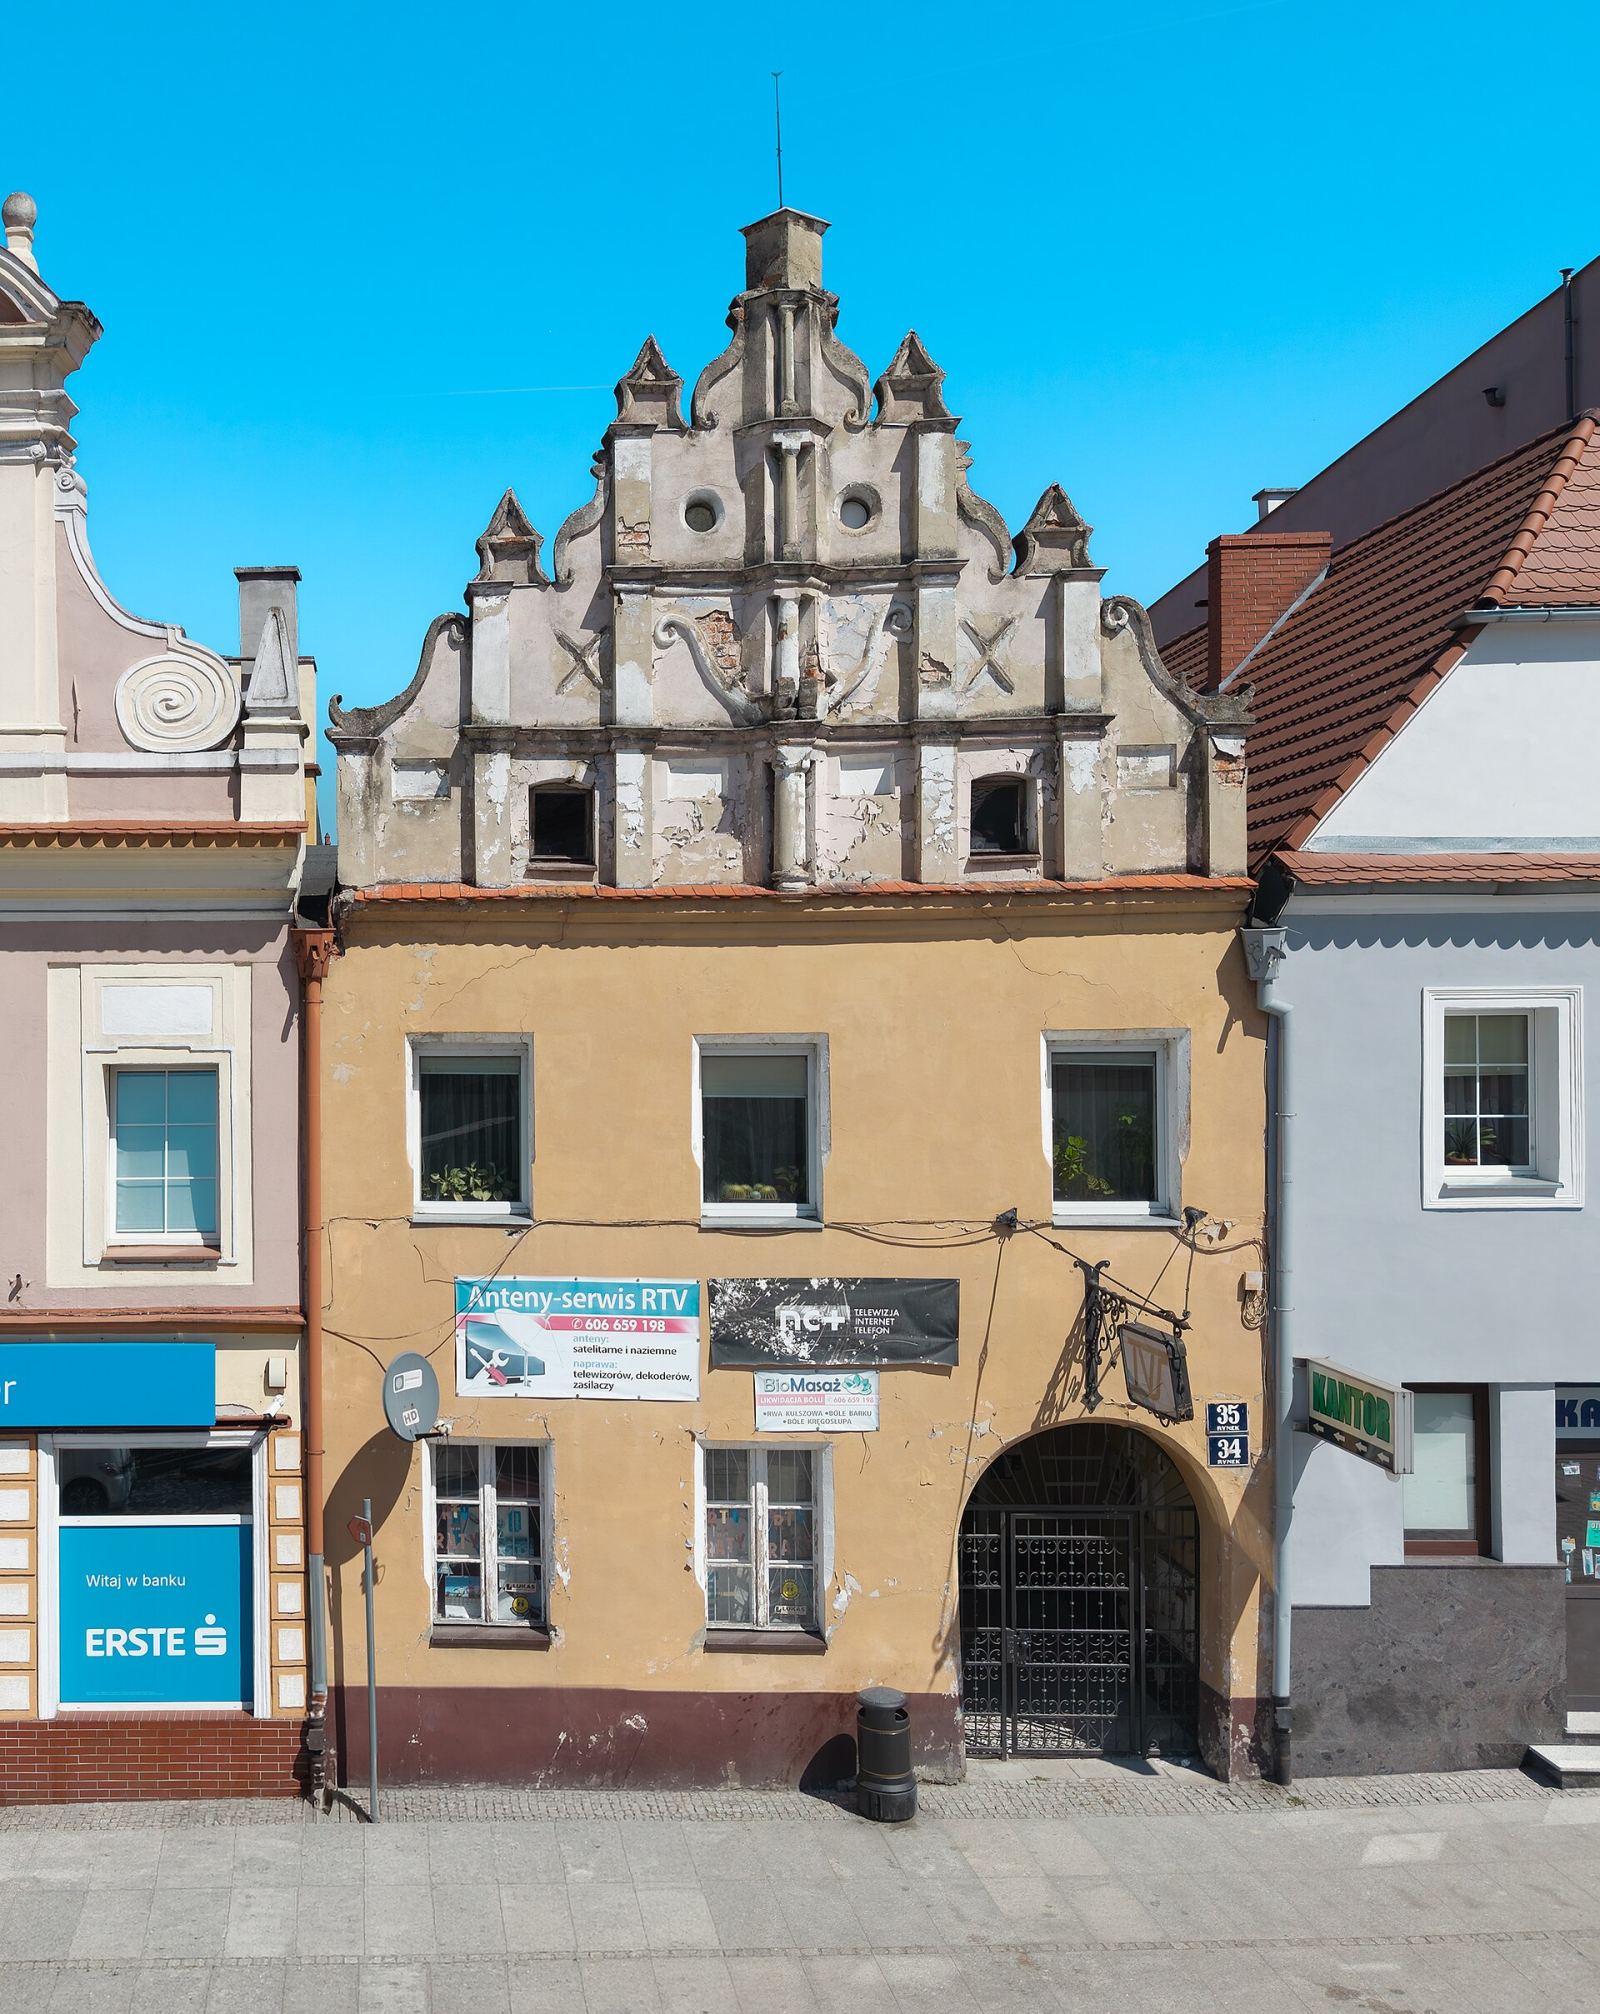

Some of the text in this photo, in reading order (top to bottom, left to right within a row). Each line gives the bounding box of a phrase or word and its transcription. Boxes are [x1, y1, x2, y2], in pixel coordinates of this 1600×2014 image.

[468, 1286, 689, 1314] Anteny-serwis RTV
[854, 1308, 900, 1317] TELEWIZJA
[585, 1319, 666, 1332] 606 659 198
[855, 1318, 895, 1326] INTERNET
[854, 1326, 890, 1335] TELEFON
[573, 1335, 609, 1345] anteny:
[573, 1344, 677, 1356] satelitarne i naziemne
[573, 1359, 619, 1370] naprawa:
[573, 1370, 693, 1382] telewizorów, dekoderów,
[573, 1380, 615, 1392] zasilaczy
[764, 1377, 841, 1392] BioMasaż
[760, 1395, 875, 1404] LIKWIDACJA BÓLU 606 659 198
[1312, 1371, 1391, 1444] KANTOR
[404, 1411, 418, 1424] HD
[1216, 1404, 1240, 1425] 35
[1218, 1438, 1241, 1459] 34
[86, 1573, 186, 1589] Witaj w banku
[86, 1627, 186, 1657] ERSTE
